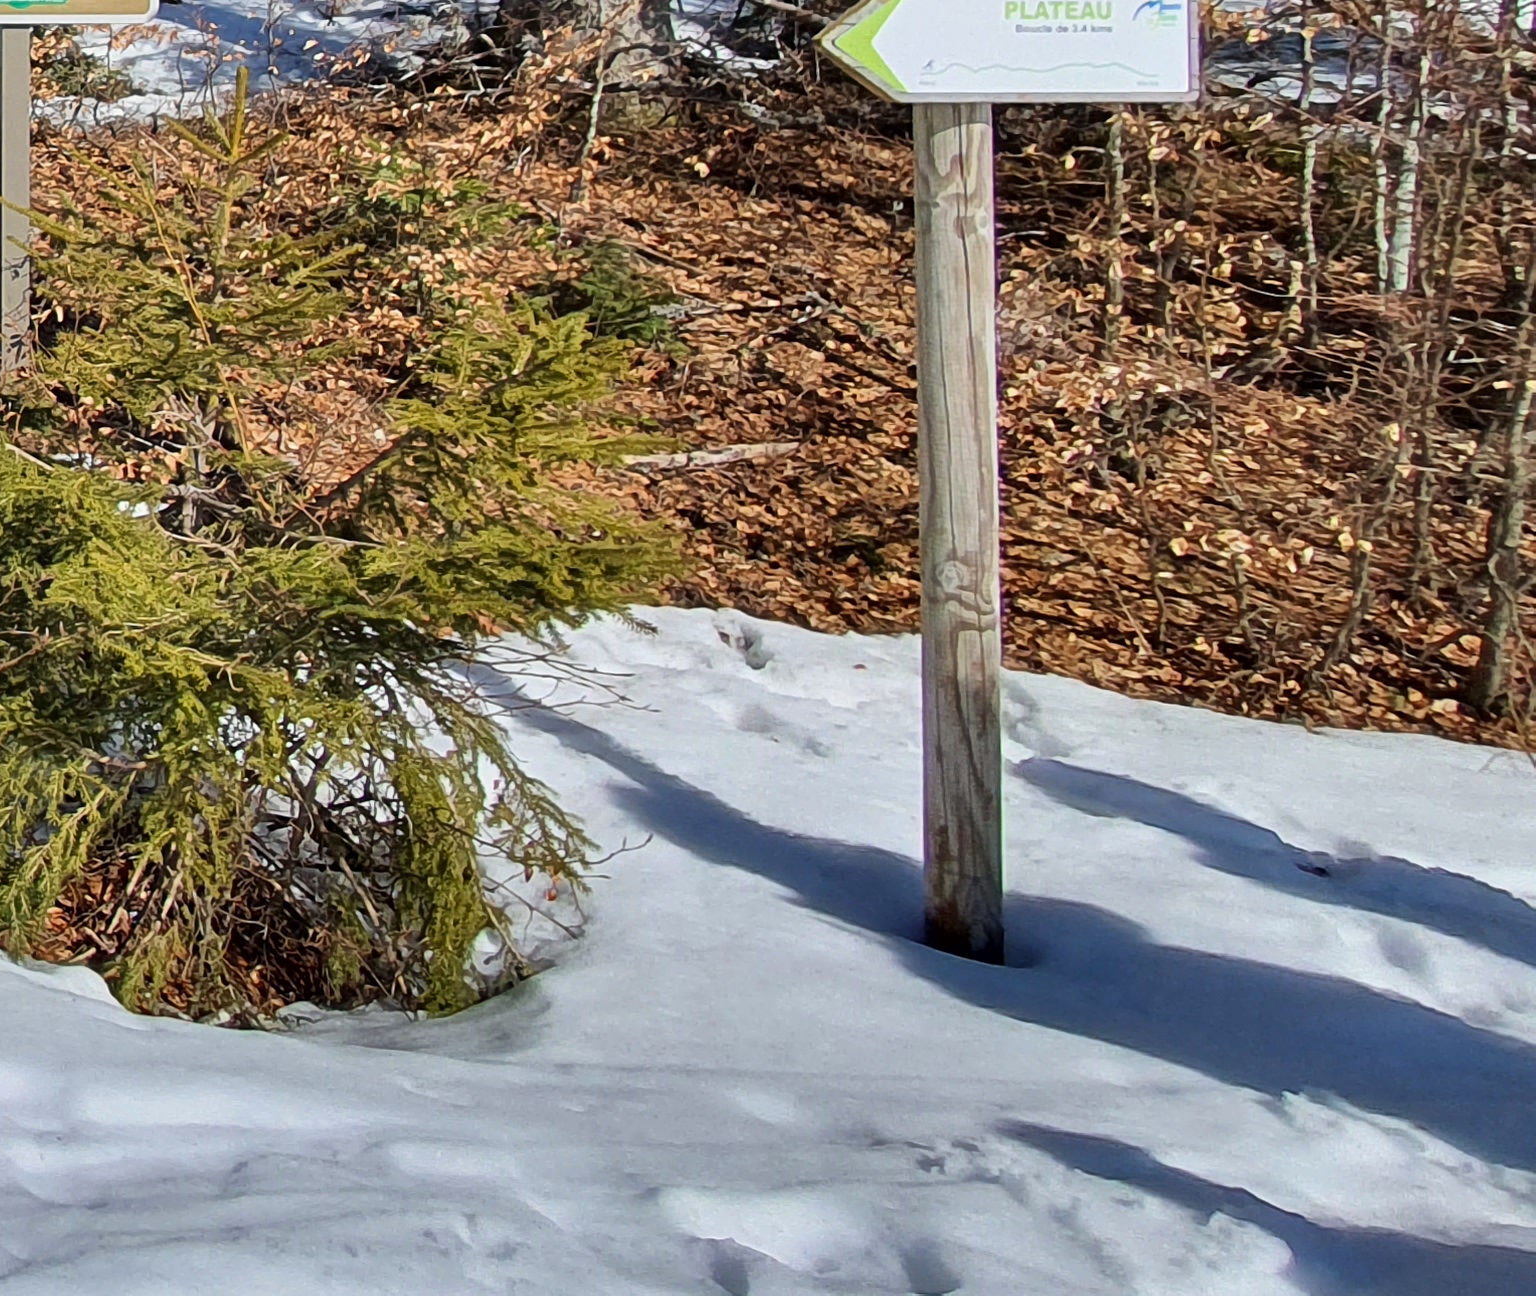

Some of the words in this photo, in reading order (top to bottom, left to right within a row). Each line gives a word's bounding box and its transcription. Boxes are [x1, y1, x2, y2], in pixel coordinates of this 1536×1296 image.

[1004, 0, 1113, 21] PLATEAU
[1015, 24, 1052, 33] Boucle
[1055, 24, 1069, 33] de
